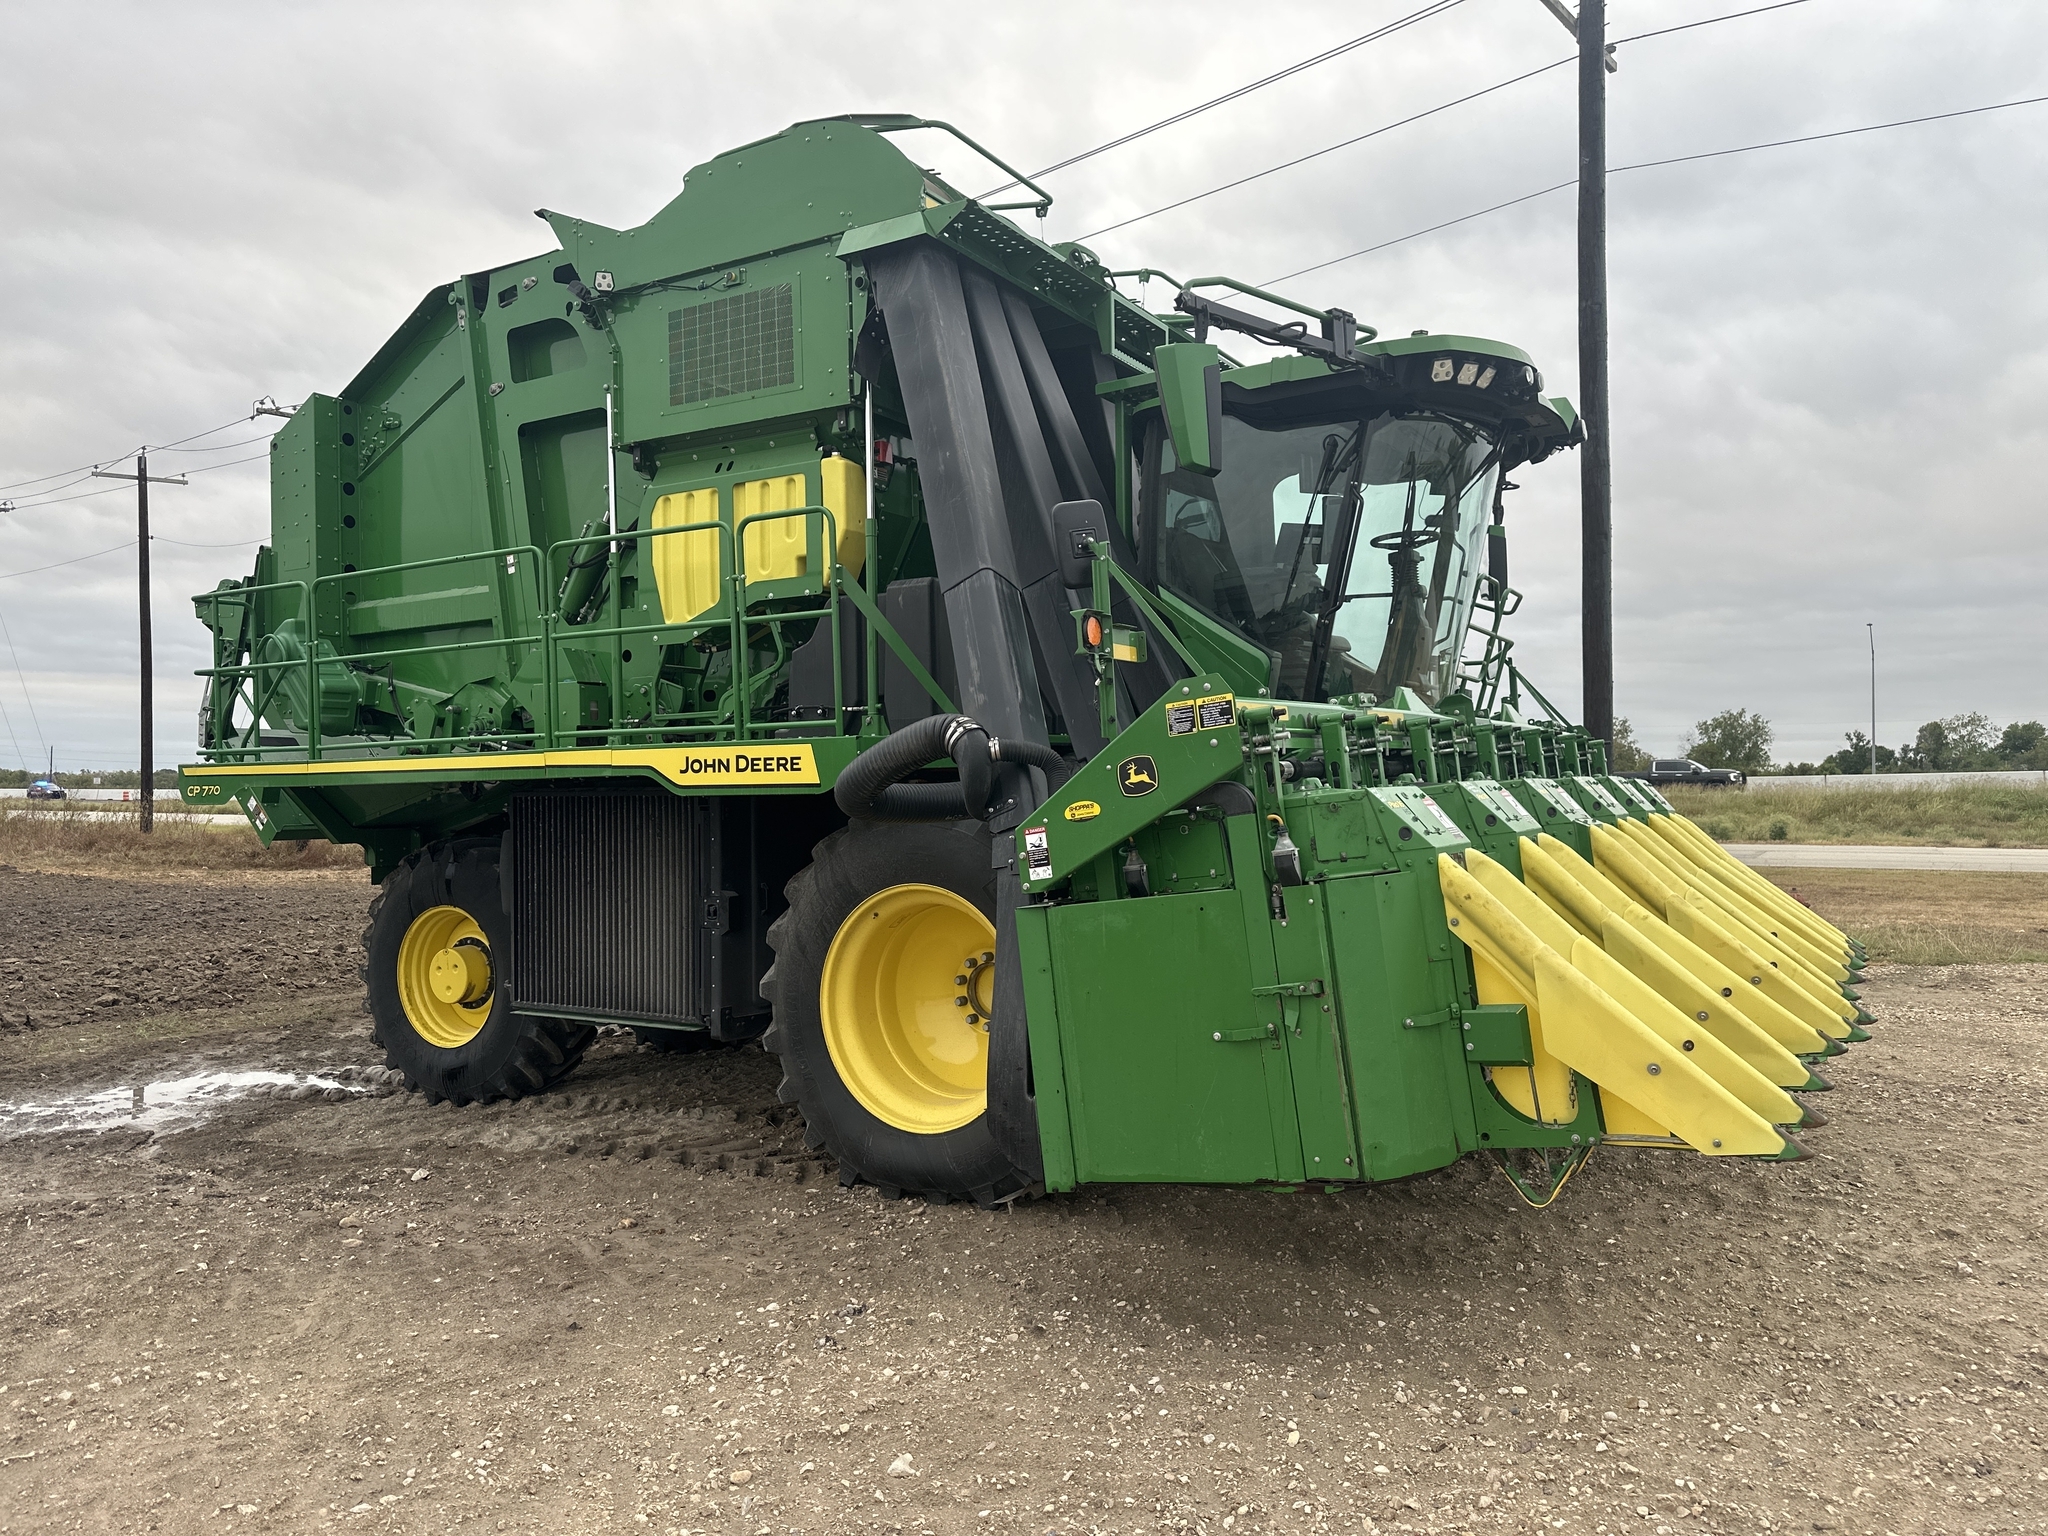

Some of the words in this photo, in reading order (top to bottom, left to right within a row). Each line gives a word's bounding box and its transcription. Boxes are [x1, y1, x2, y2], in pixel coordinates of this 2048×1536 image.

[680, 756, 730, 774] JOHN
[735, 755, 802, 773] DEERE
[187, 786, 200, 797] CP
[202, 785, 220, 797] 770
